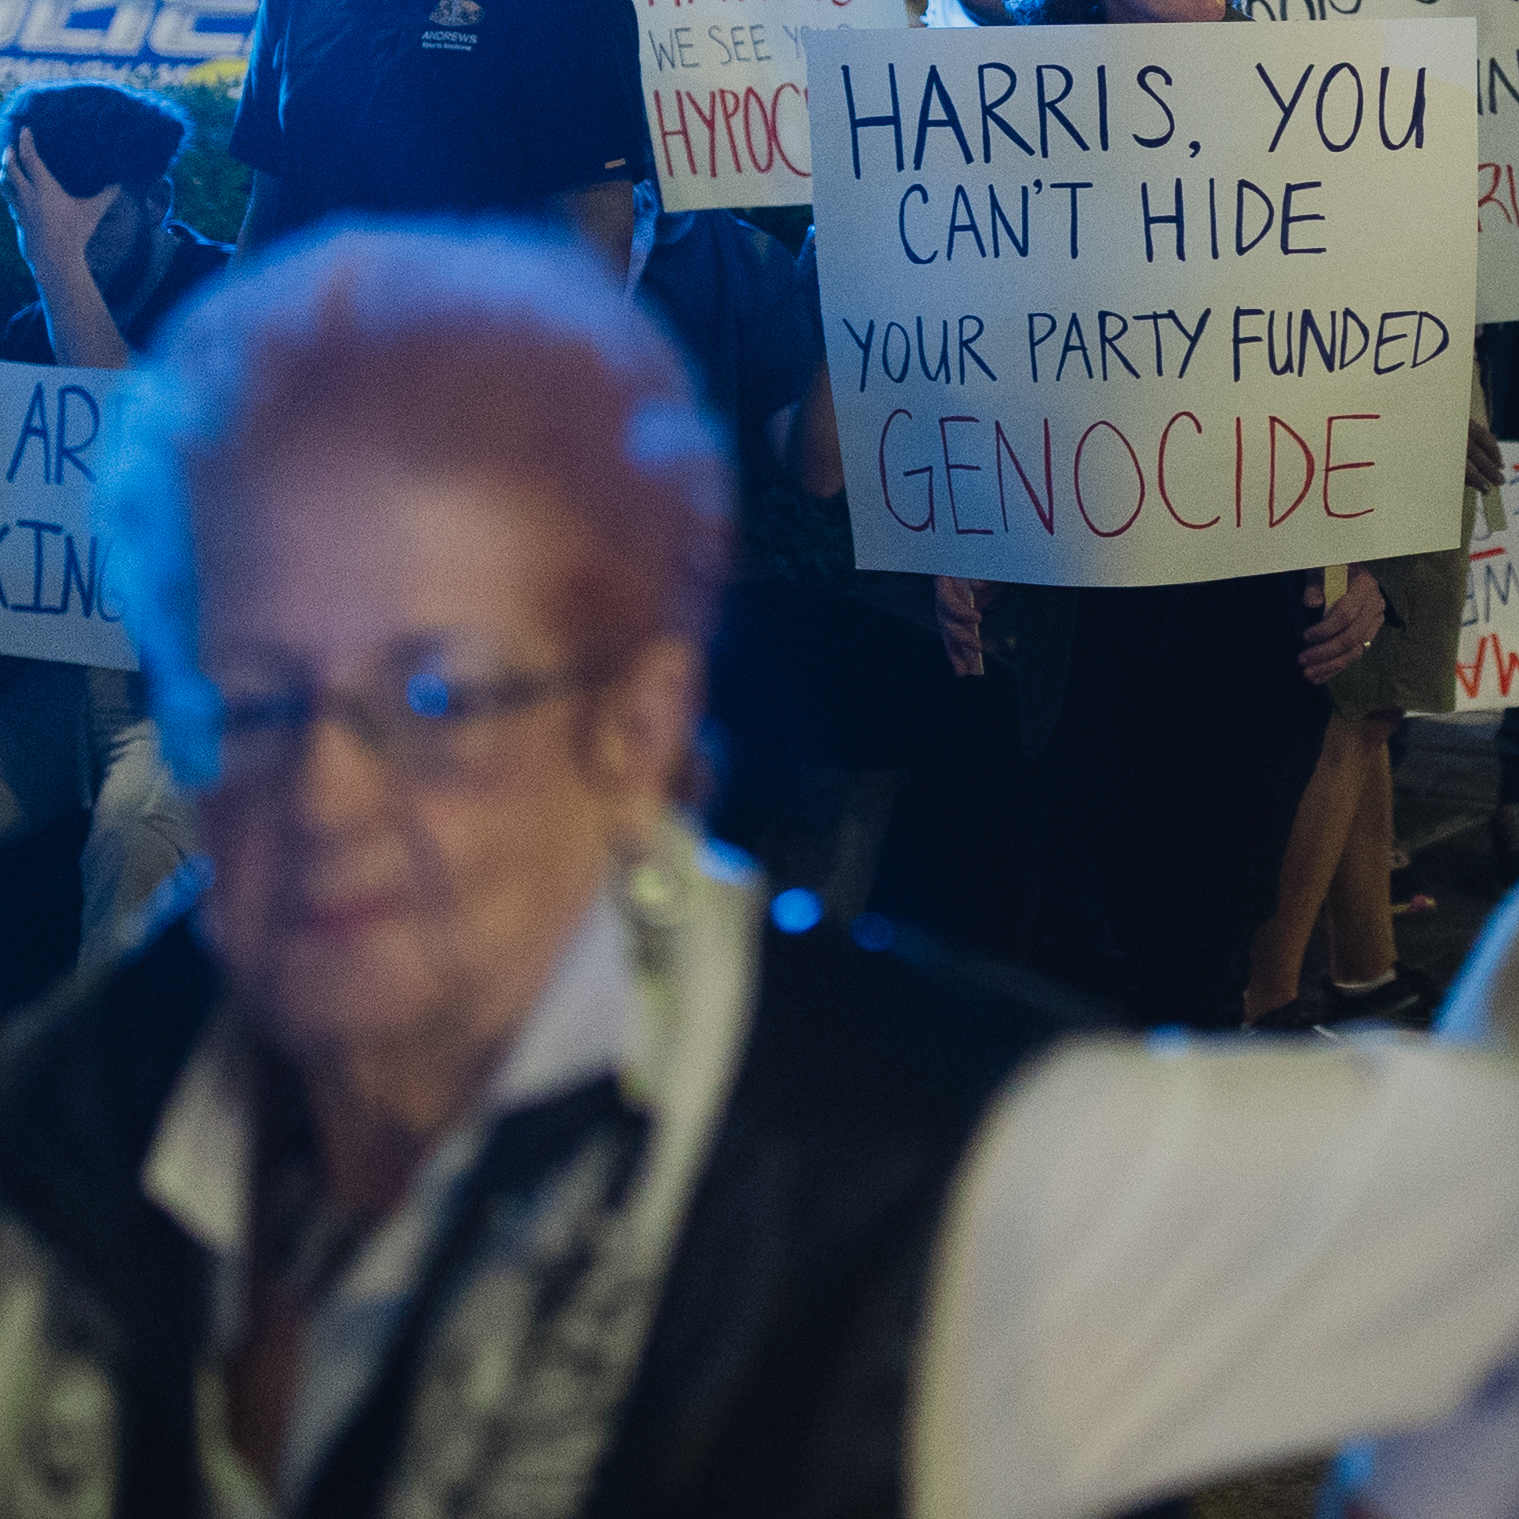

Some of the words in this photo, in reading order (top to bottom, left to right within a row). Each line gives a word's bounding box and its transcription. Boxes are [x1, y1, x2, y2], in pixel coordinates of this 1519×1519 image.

[647, 25, 700, 72] WE
[707, 23, 773, 65] SEE
[652, 82, 813, 178] HYPOC
[840, 61, 1203, 180] HARRIS,
[1255, 62, 1428, 153] YOU
[897, 178, 1094, 265] CAN'T
[1141, 177, 1328, 263] HIDE
[841, 313, 999, 393] YOUR
[1026, 306, 1213, 384] PARTY
[1231, 306, 1451, 383] FUNDED
[5, 381, 105, 485] AR
[877, 408, 1381, 539] GENOCIDE
